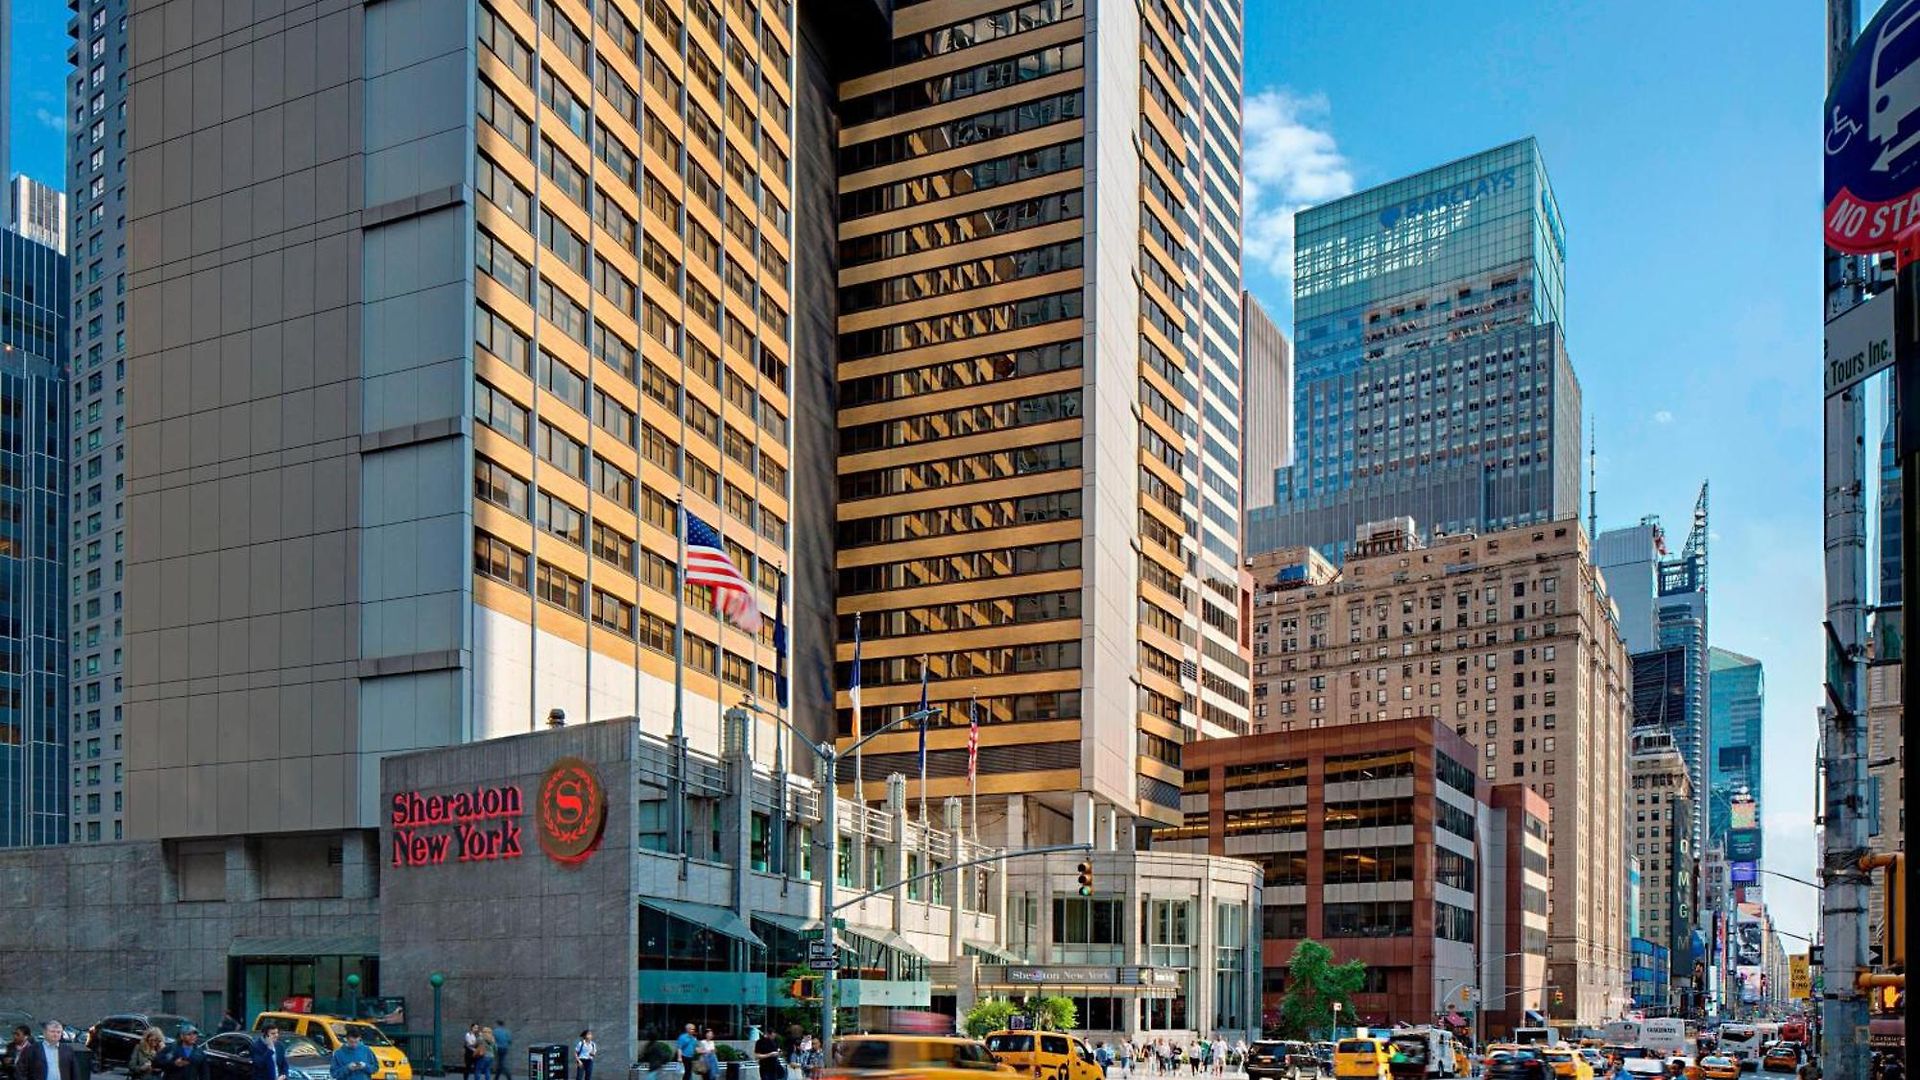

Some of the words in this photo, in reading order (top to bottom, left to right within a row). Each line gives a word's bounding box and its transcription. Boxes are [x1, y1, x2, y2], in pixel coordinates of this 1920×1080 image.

[1406, 168, 1516, 217] BARCLAYS
[1829, 199, 1867, 238] NO
[1831, 351, 1864, 386] Tours
[1869, 339, 1892, 367] Inc.
[392, 785, 522, 826] Sheraton
[555, 780, 583, 825] S
[392, 829, 450, 867] New
[453, 821, 523, 863] York
[1012, 969, 1060, 981] Sheton
[1064, 970, 1084, 981] New
